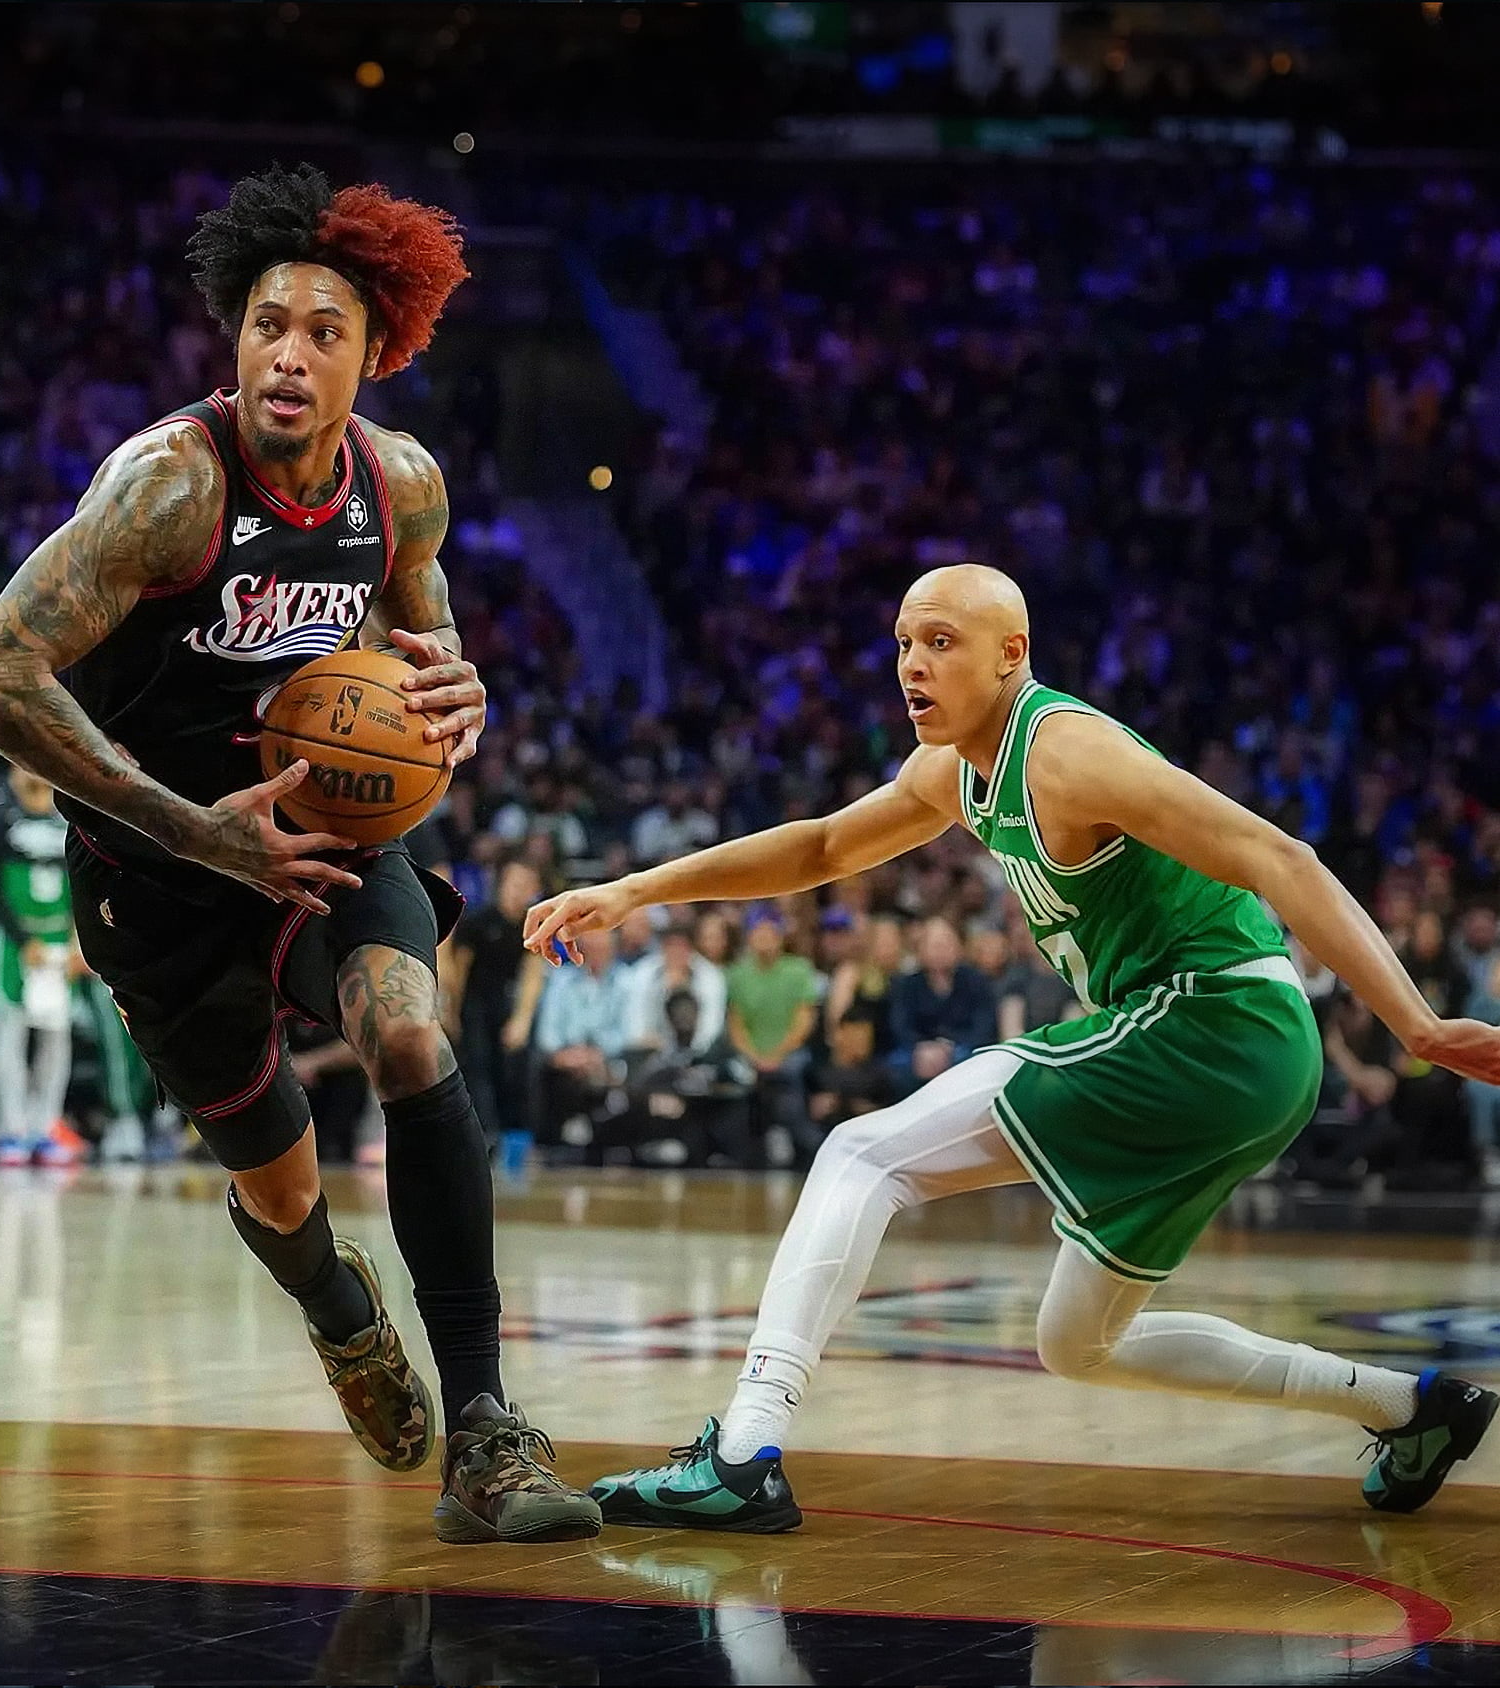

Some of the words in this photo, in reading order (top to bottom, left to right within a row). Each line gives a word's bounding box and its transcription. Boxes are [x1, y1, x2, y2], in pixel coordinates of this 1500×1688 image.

[237, 516, 261, 533] NIKE
[337, 536, 380, 549] crypto.com
[998, 812, 1027, 828] Amica
